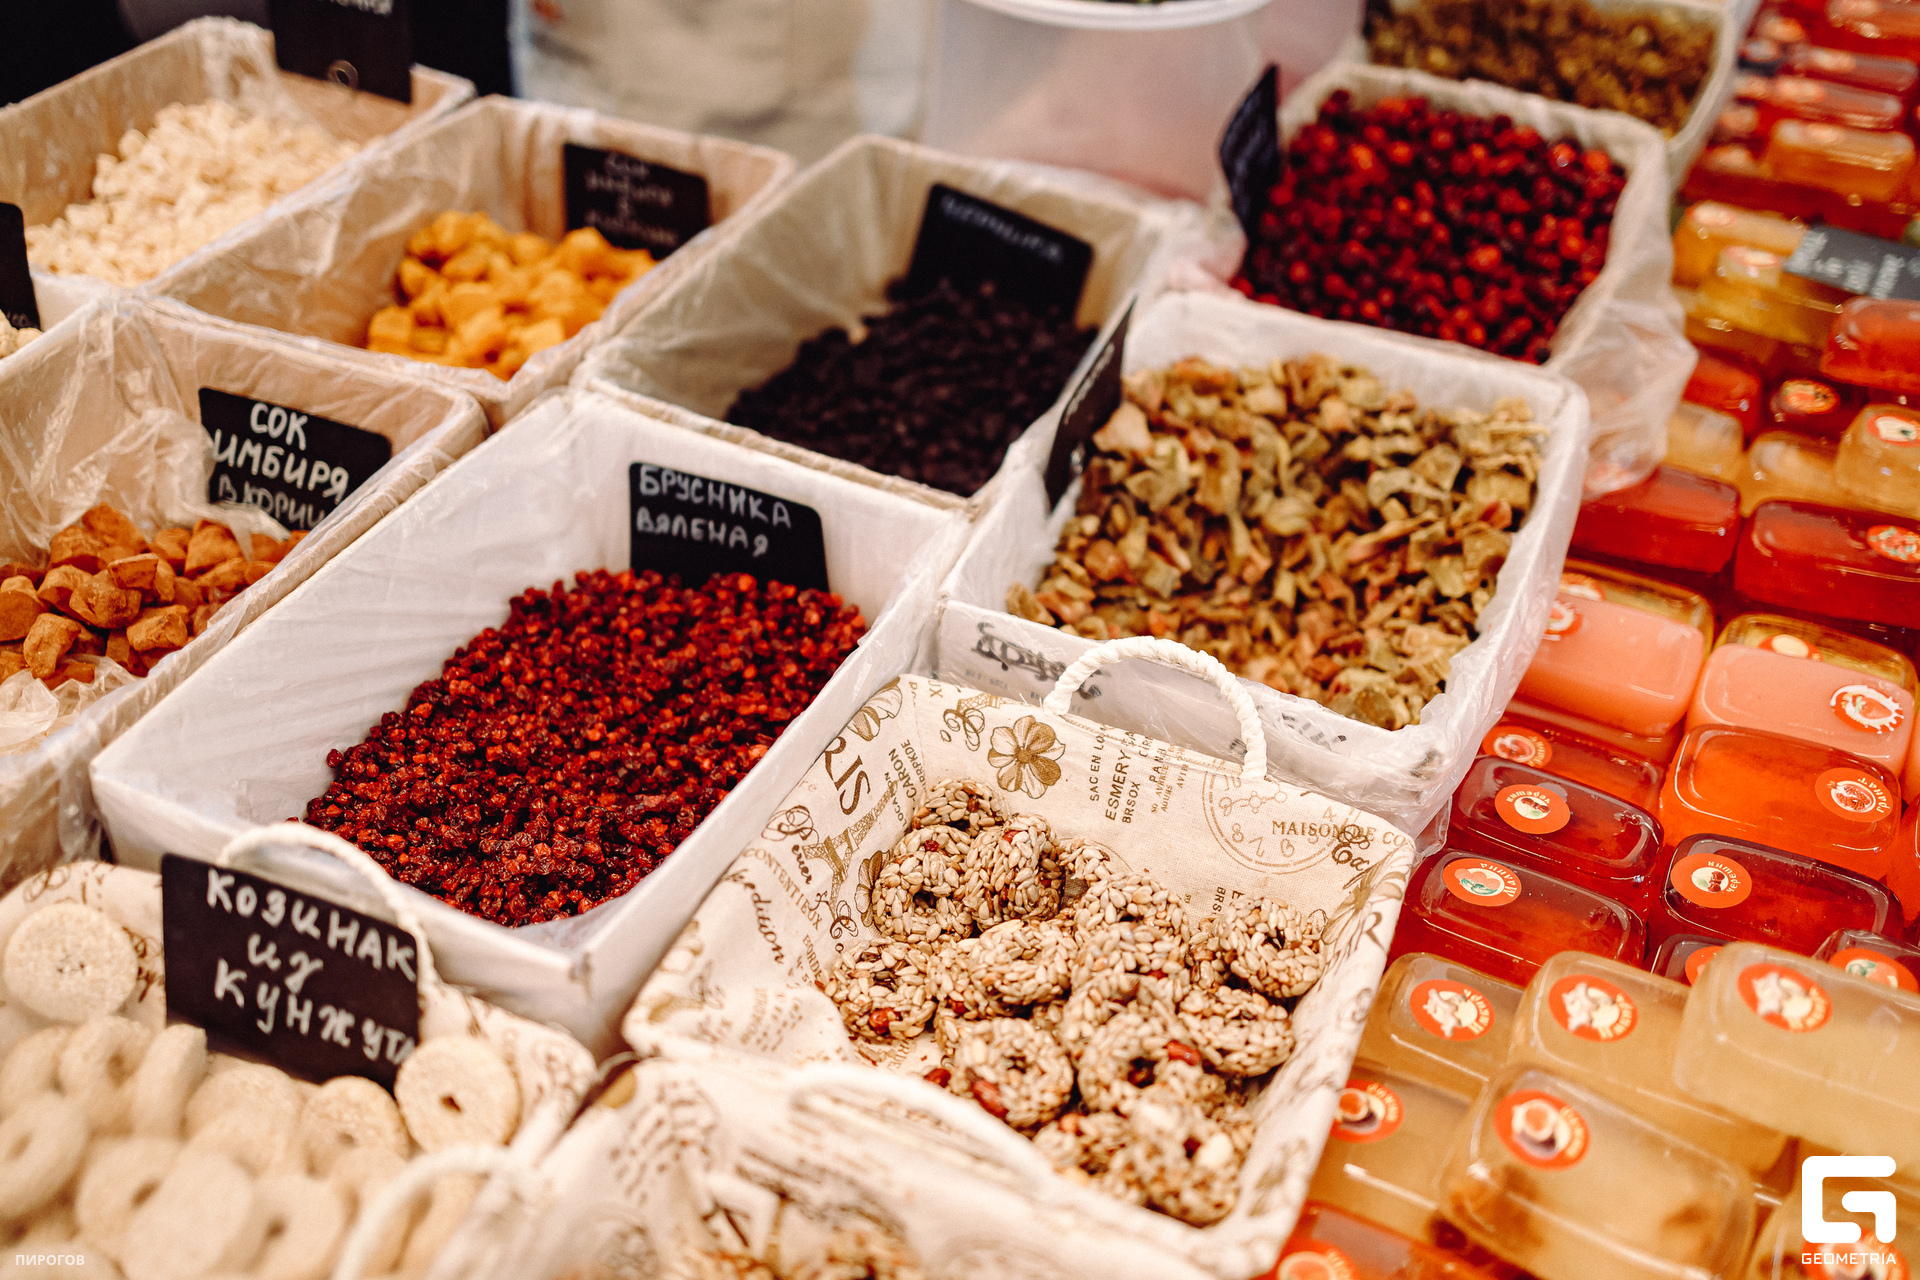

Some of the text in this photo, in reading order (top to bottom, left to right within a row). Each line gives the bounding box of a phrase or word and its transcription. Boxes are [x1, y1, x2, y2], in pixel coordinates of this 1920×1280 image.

[250, 402, 308, 451] СОК
[213, 428, 350, 505] ИМБИРЯ
[639, 463, 792, 529] БРУСНИКА
[636, 505, 768, 558] ВЯЛЕНАЯ
[1105, 749, 1131, 821] ESMERY
[206, 867, 417, 983] КОЗИНАК
